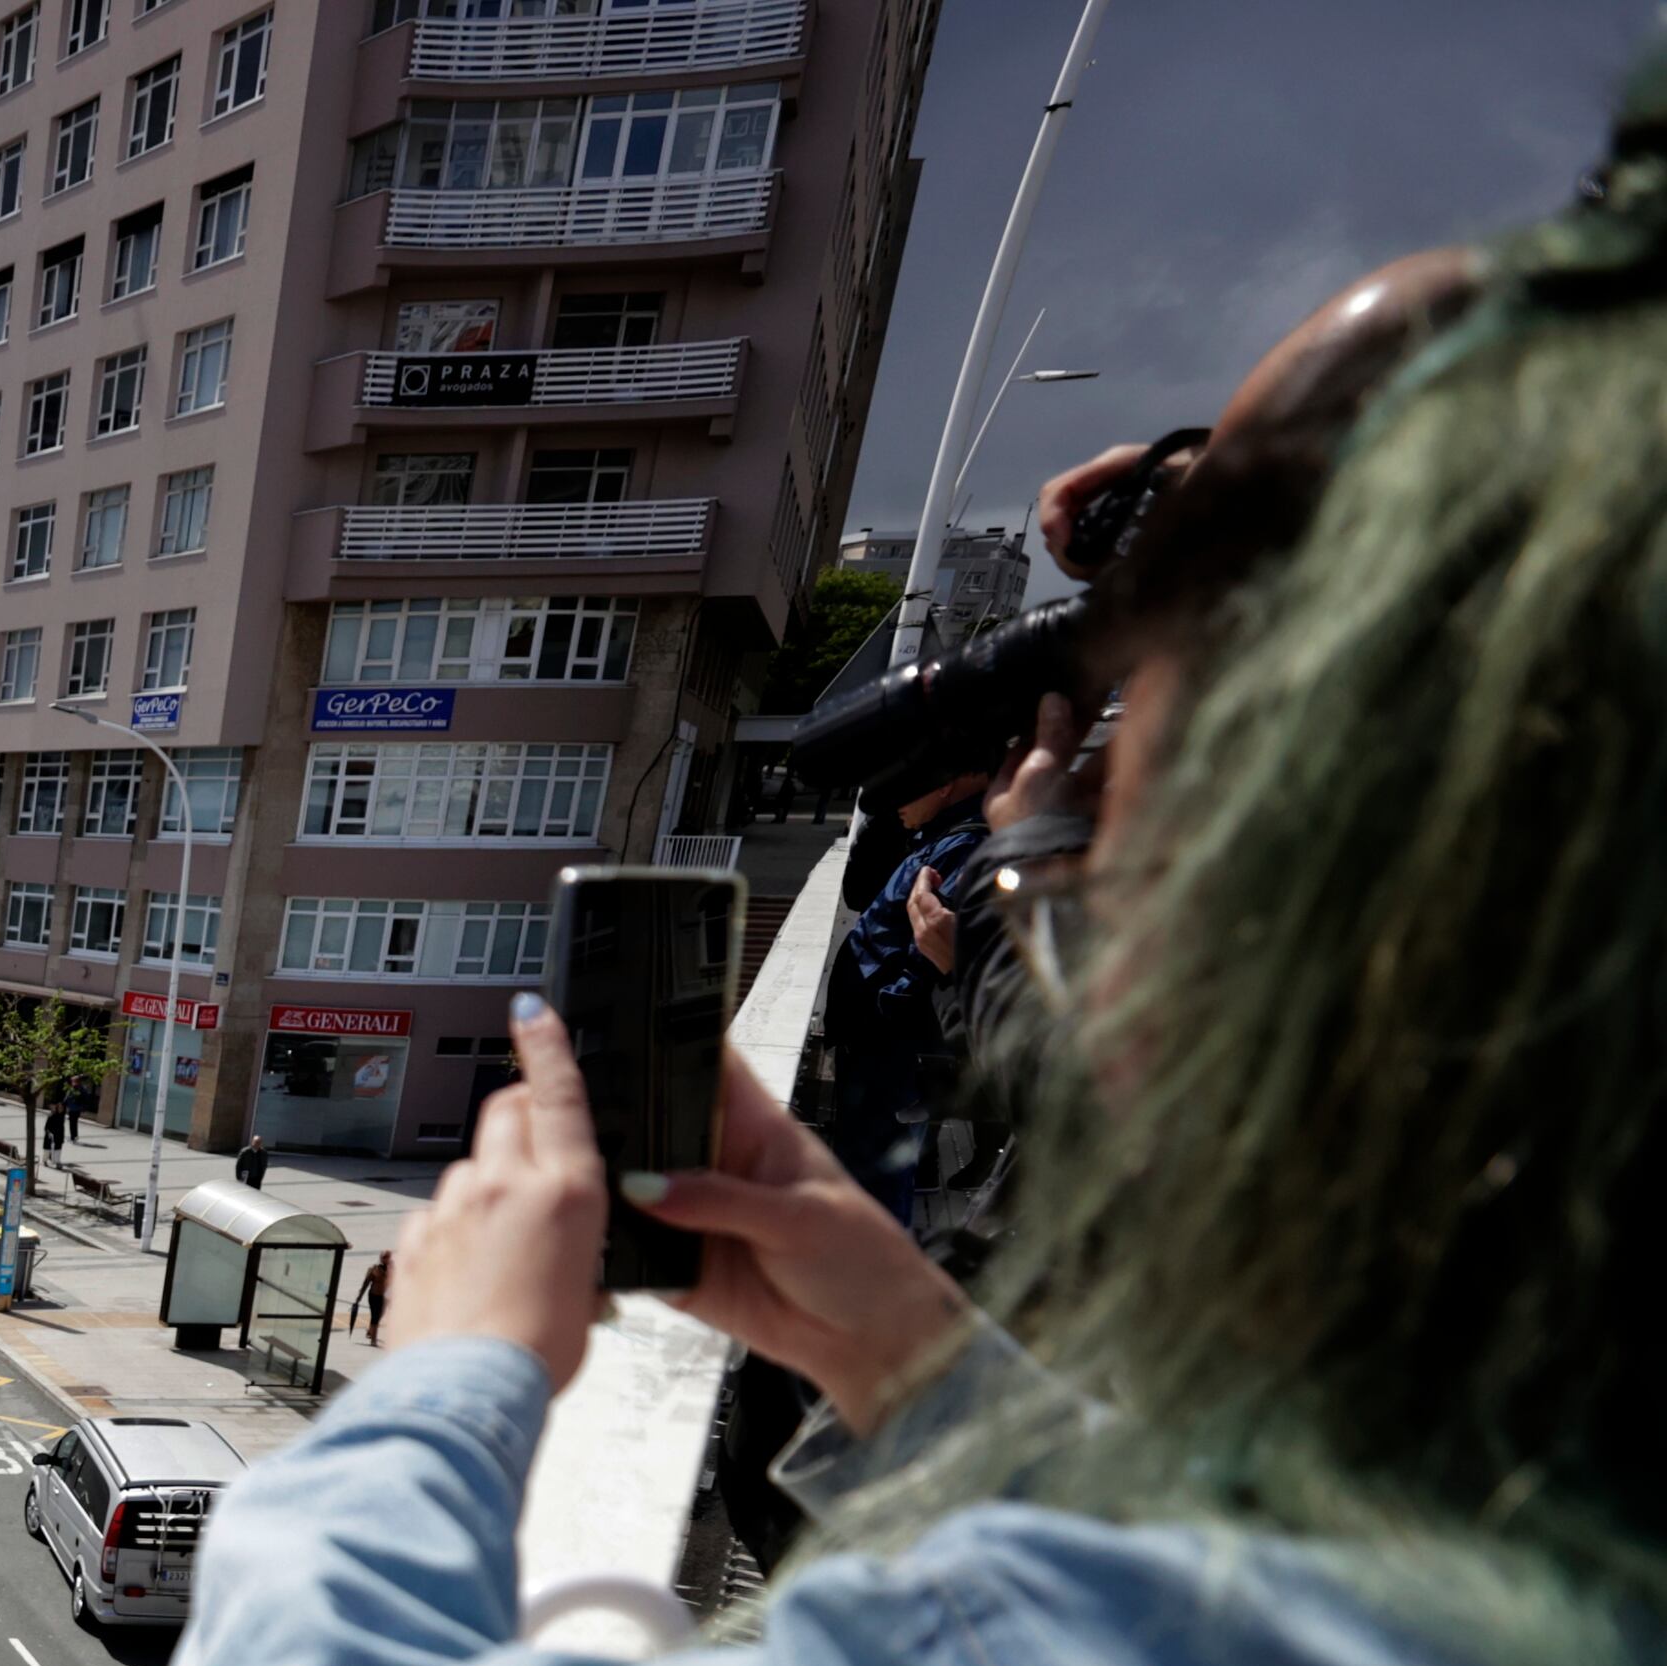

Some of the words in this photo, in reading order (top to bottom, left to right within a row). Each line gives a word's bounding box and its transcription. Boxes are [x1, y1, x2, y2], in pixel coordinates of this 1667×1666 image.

[440, 363, 530, 380] PRAZA
[439, 382, 494, 393] avogados
[133, 695, 180, 714] GerPeCo
[326, 692, 444, 716] GerPeCo
[306, 1010, 400, 1032] GENERALI
